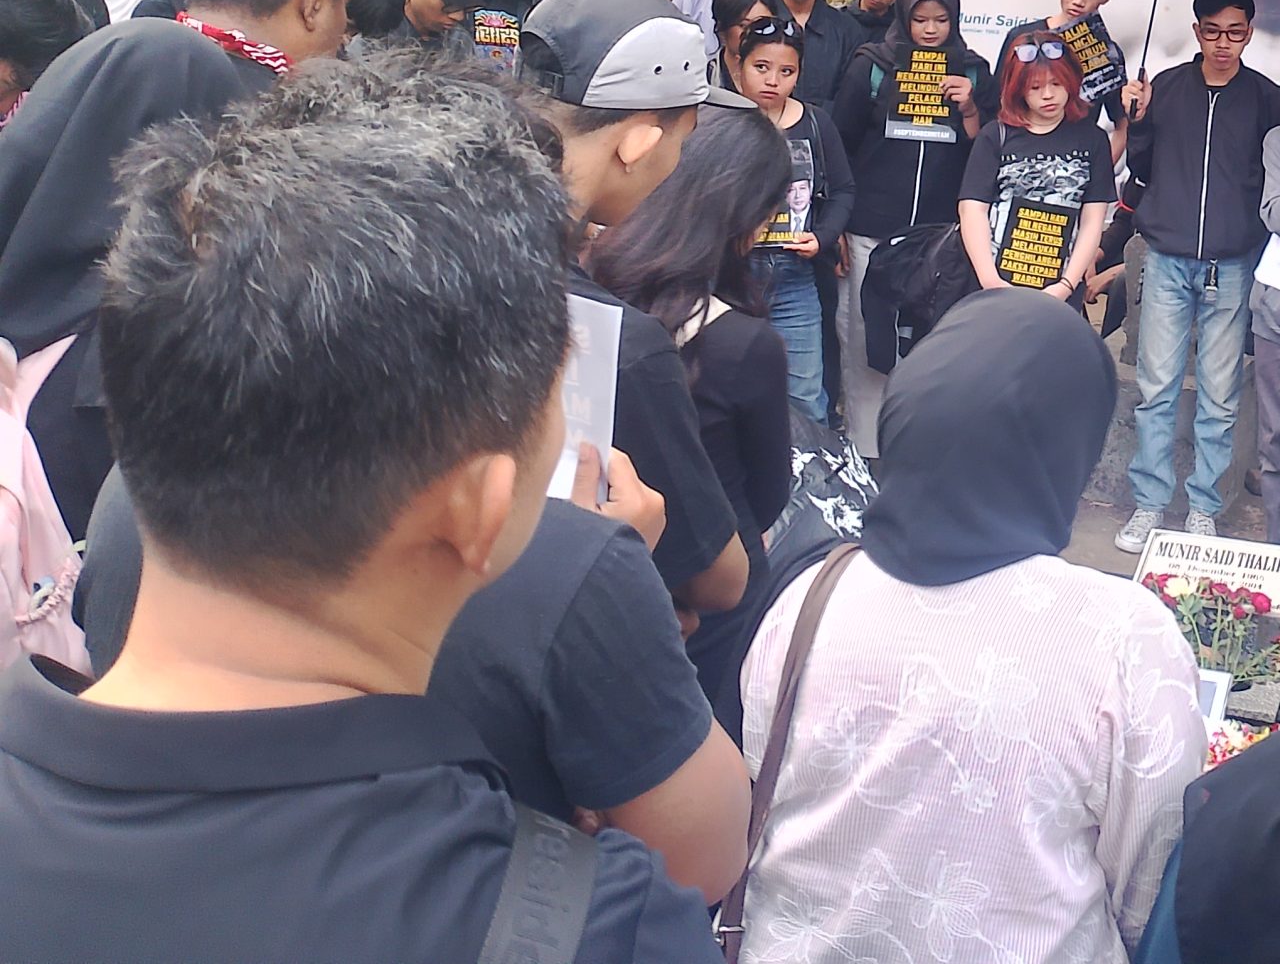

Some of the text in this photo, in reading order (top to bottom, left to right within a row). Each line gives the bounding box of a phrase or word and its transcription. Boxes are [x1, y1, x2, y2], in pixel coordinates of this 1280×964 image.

[960, 13, 992, 26] unir
[912, 51, 947, 62] SAMPAI
[1078, 41, 1108, 62] UNUH
[912, 62, 946, 73] HARI INI
[908, 94, 942, 104] PELAKU
[898, 104, 950, 116] PELANGGAR
[912, 116, 933, 126] HAM
[1018, 207, 1049, 221] SAMPAI
[1012, 228, 1064, 247] MASIH TERUS
[1011, 240, 1059, 257] MELAKUKAN
[1002, 248, 1062, 268] PENGHILANGAN
[1000, 259, 1058, 278] PAKSA KEPADA
[1156, 541, 1201, 561] MUNIR
[1202, 545, 1234, 566] SAID
